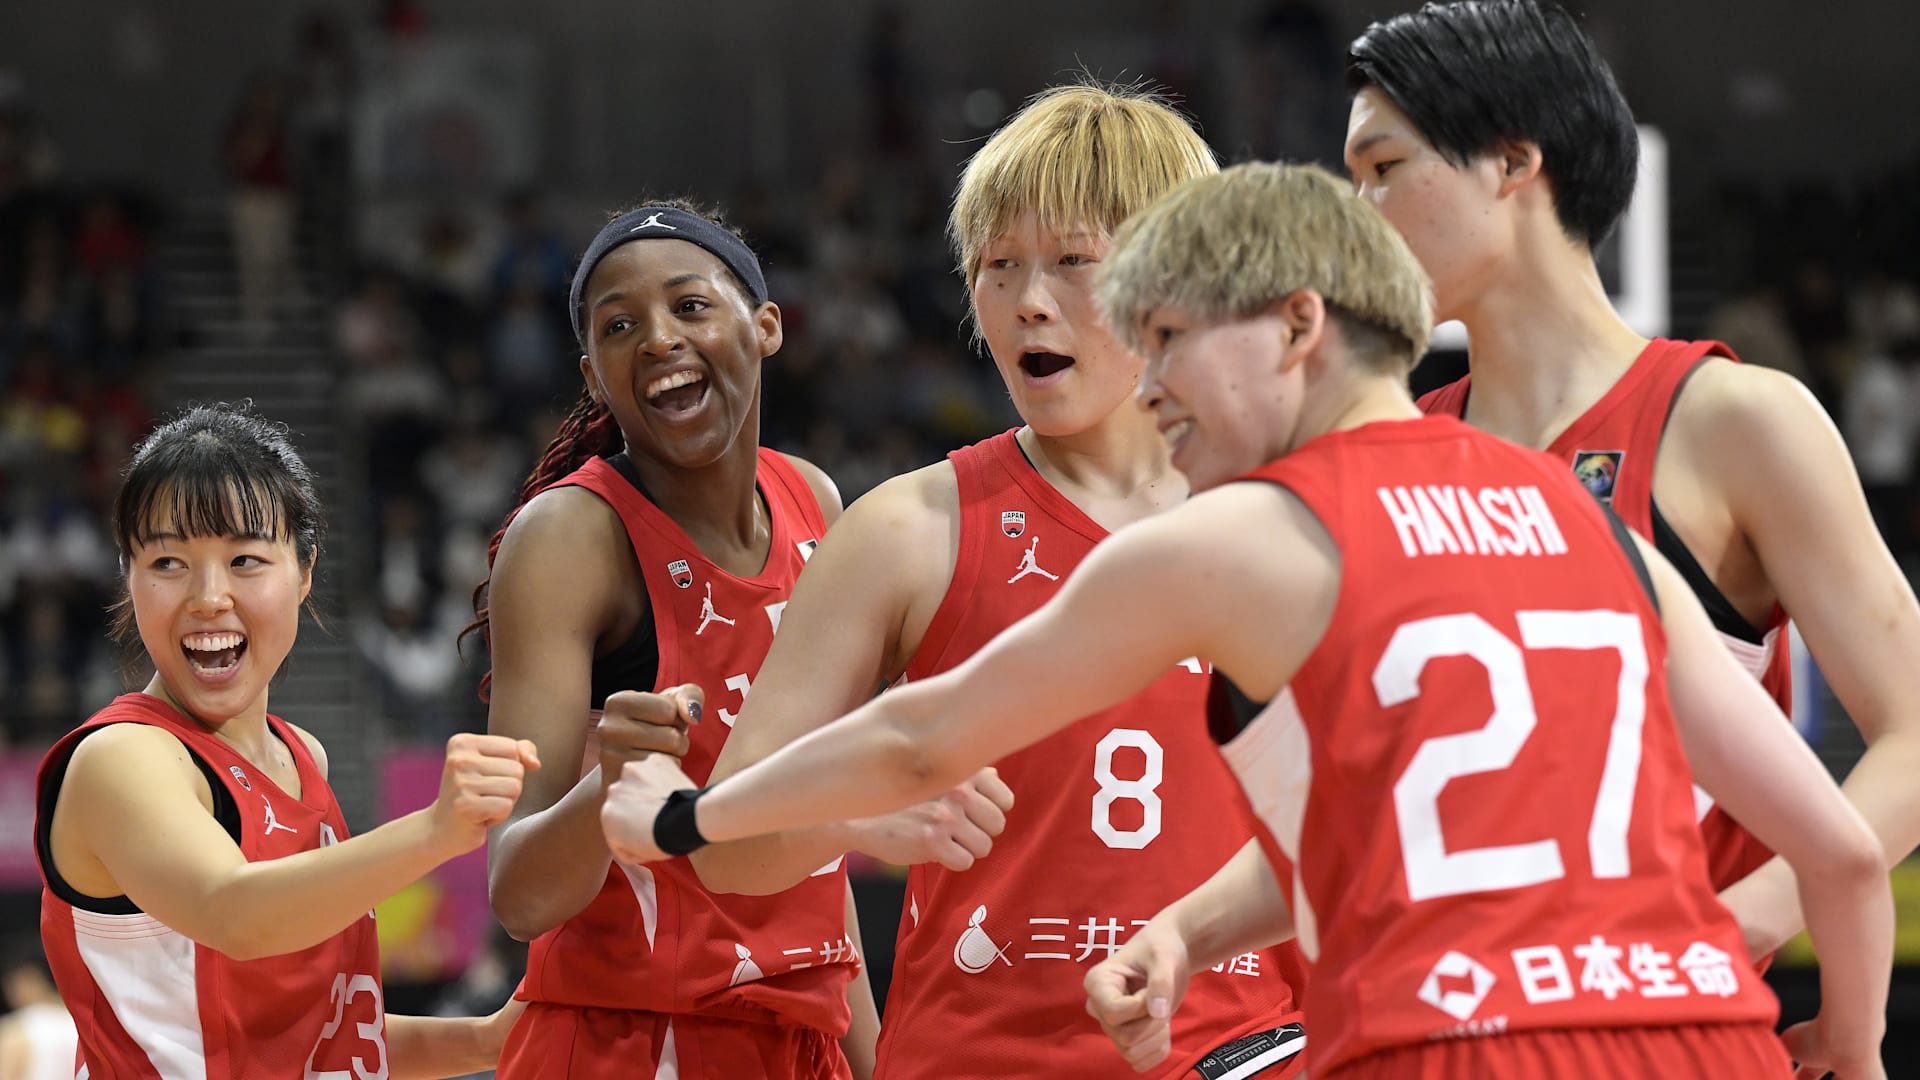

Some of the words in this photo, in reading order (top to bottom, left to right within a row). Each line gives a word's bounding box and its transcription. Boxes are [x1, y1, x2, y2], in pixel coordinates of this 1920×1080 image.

[1377, 485, 1568, 558] HAYASHI
[1091, 728, 1164, 849] 8
[1372, 609, 1649, 901] 27
[1511, 935, 1740, 1005] 日本生命
[304, 972, 390, 1080] 23
[1202, 1057, 1217, 1068] 48
